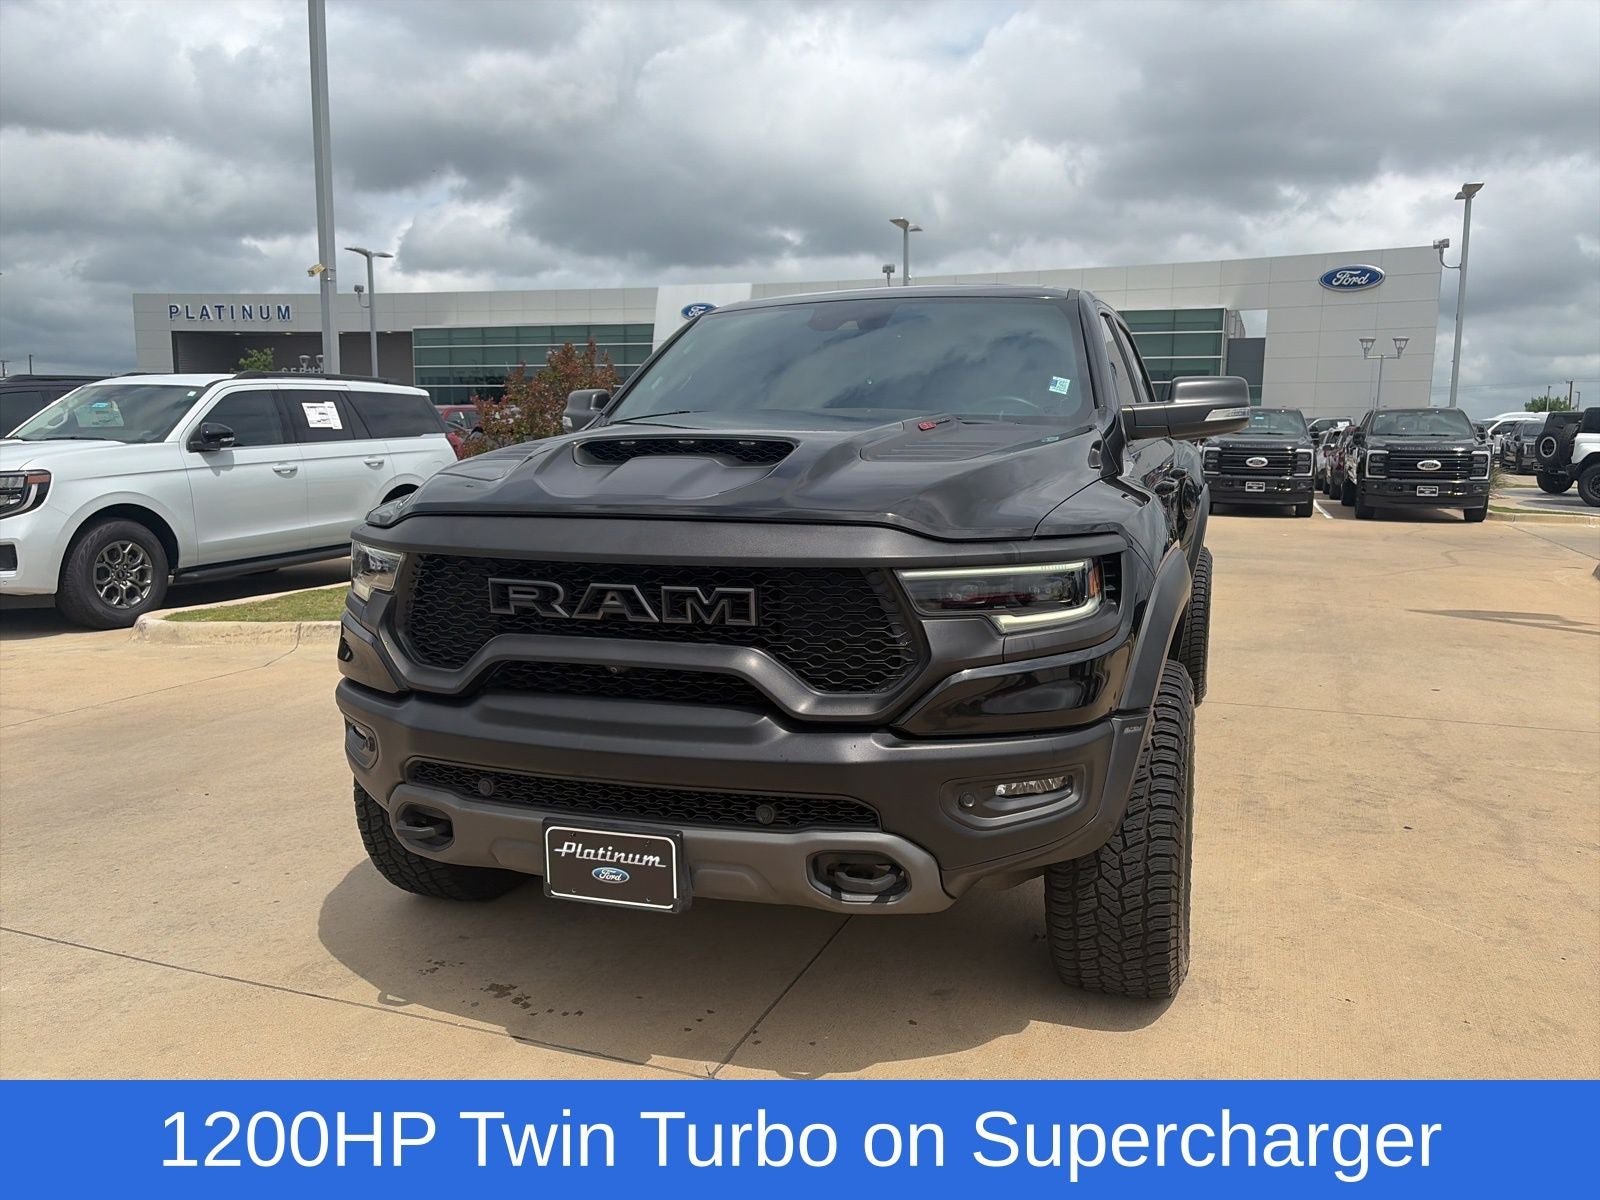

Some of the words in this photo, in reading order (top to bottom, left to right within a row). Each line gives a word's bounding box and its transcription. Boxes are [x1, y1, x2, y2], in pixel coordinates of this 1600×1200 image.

[1332, 270, 1371, 286] Ford
[168, 304, 291, 320] PLATINUM
[488, 577, 756, 626] RAM
[553, 841, 667, 868] Platinum
[599, 868, 622, 882] Ford
